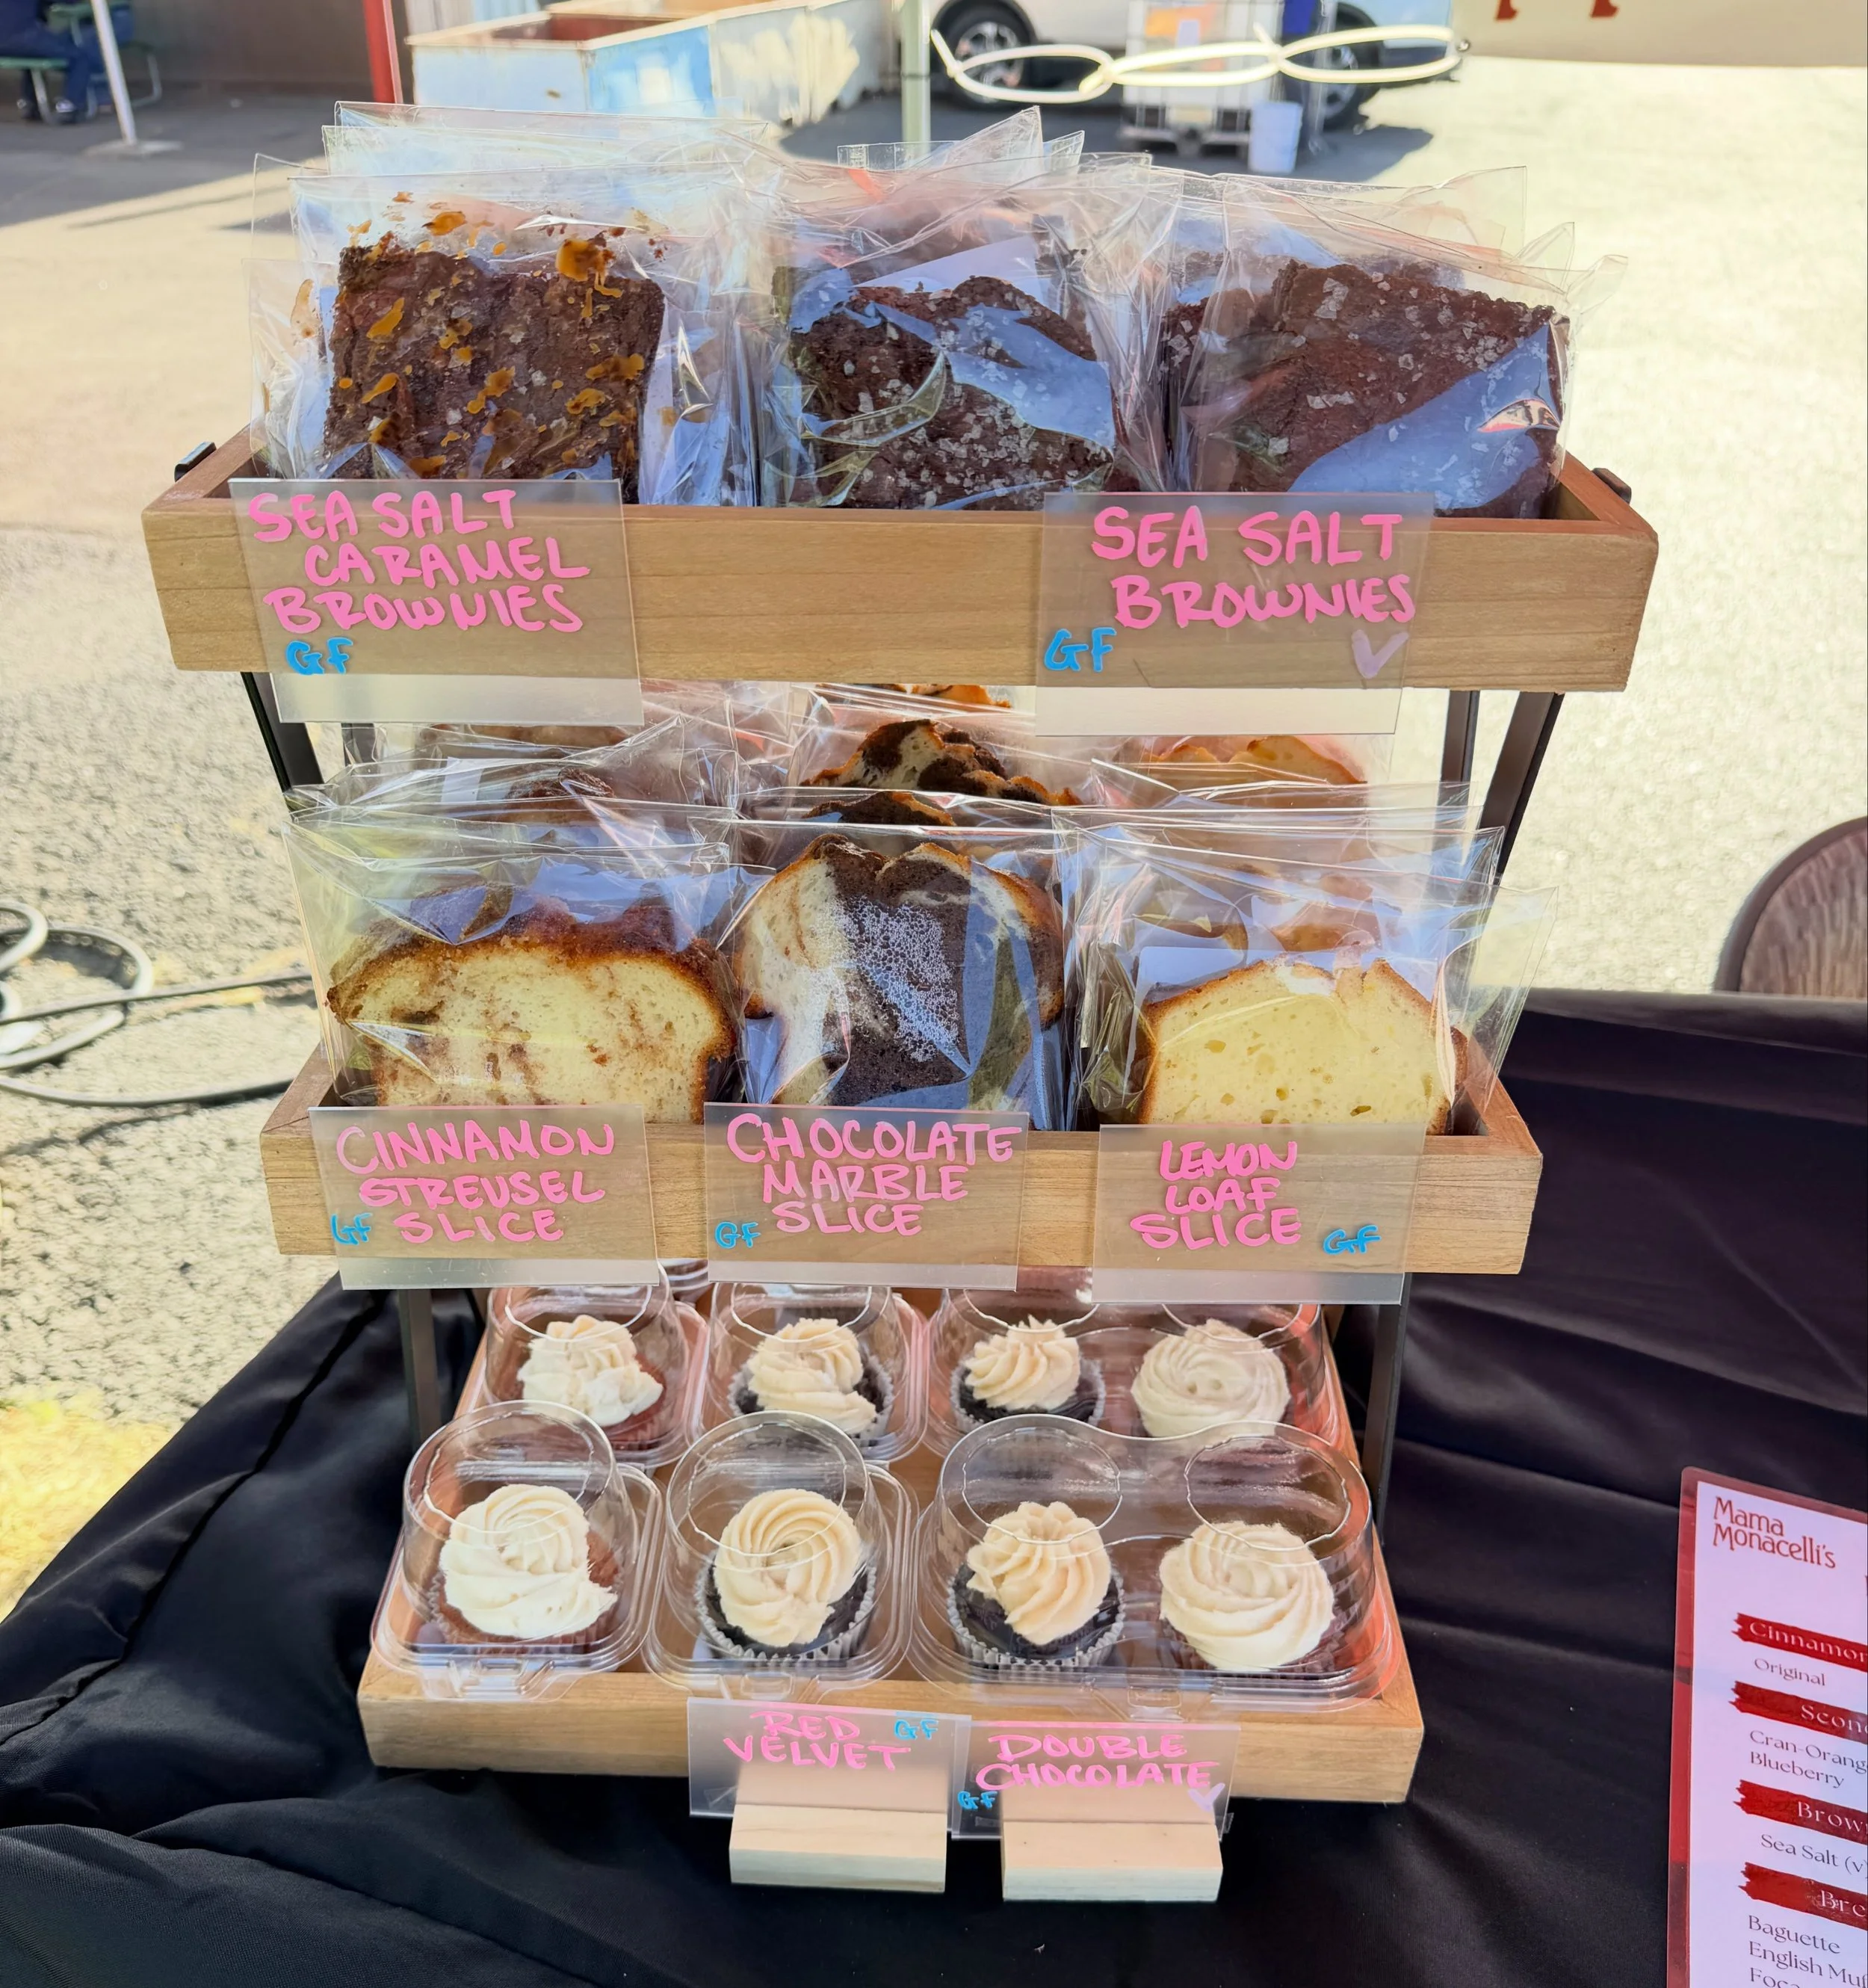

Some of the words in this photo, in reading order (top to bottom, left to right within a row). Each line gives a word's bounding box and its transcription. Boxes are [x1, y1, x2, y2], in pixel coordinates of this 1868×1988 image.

[249, 490, 359, 542] SEA
[372, 489, 516, 539] SALT
[1092, 505, 1208, 568] SEA
[1238, 510, 1402, 566] SALT
[304, 537, 591, 588] CARAMEL
[263, 584, 584, 634] BROWNIES
[1110, 574, 1416, 629] BROWNIES
[285, 637, 353, 675] GF
[1043, 627, 1117, 672] GF
[336, 1120, 615, 1174] CINNAMON
[726, 1112, 1022, 1165] CHOCOLATE
[1159, 1140, 1298, 1181] LEMON
[359, 1170, 605, 1210] STREUSEL
[762, 1159, 968, 1203] MARBLE
[1165, 1177, 1281, 1214] LOAF
[330, 1212, 373, 1247] GF
[393, 1209, 563, 1244] SLICE
[714, 1221, 761, 1249] GF
[771, 1201, 924, 1236] SLICE
[1129, 1208, 1302, 1250] SLICE
[1323, 1224, 1382, 1256] GF
[1713, 1496, 1784, 1537] Mama
[1712, 1522, 1837, 1569] Monacelli's
[1754, 1658, 1827, 1686] Original
[749, 1711, 861, 1740] RED
[894, 1718, 939, 1740] GF
[723, 1735, 912, 1771] VELVET
[988, 1734, 1187, 1762] DOUBLE
[1749, 1729, 1868, 1775] Cran-Orang
[975, 1761, 1220, 1791] CHOCOLATE
[1750, 1751, 1846, 1788] Blueberry
[957, 1791, 998, 1809] GF
[1797, 1800, 1868, 1836] Brow
[1760, 1833, 1796, 1856] Sea
[1801, 1845, 1840, 1867] Salt
[1748, 1915, 1841, 1954] Baguette
[1749, 1941, 1823, 1976] English
